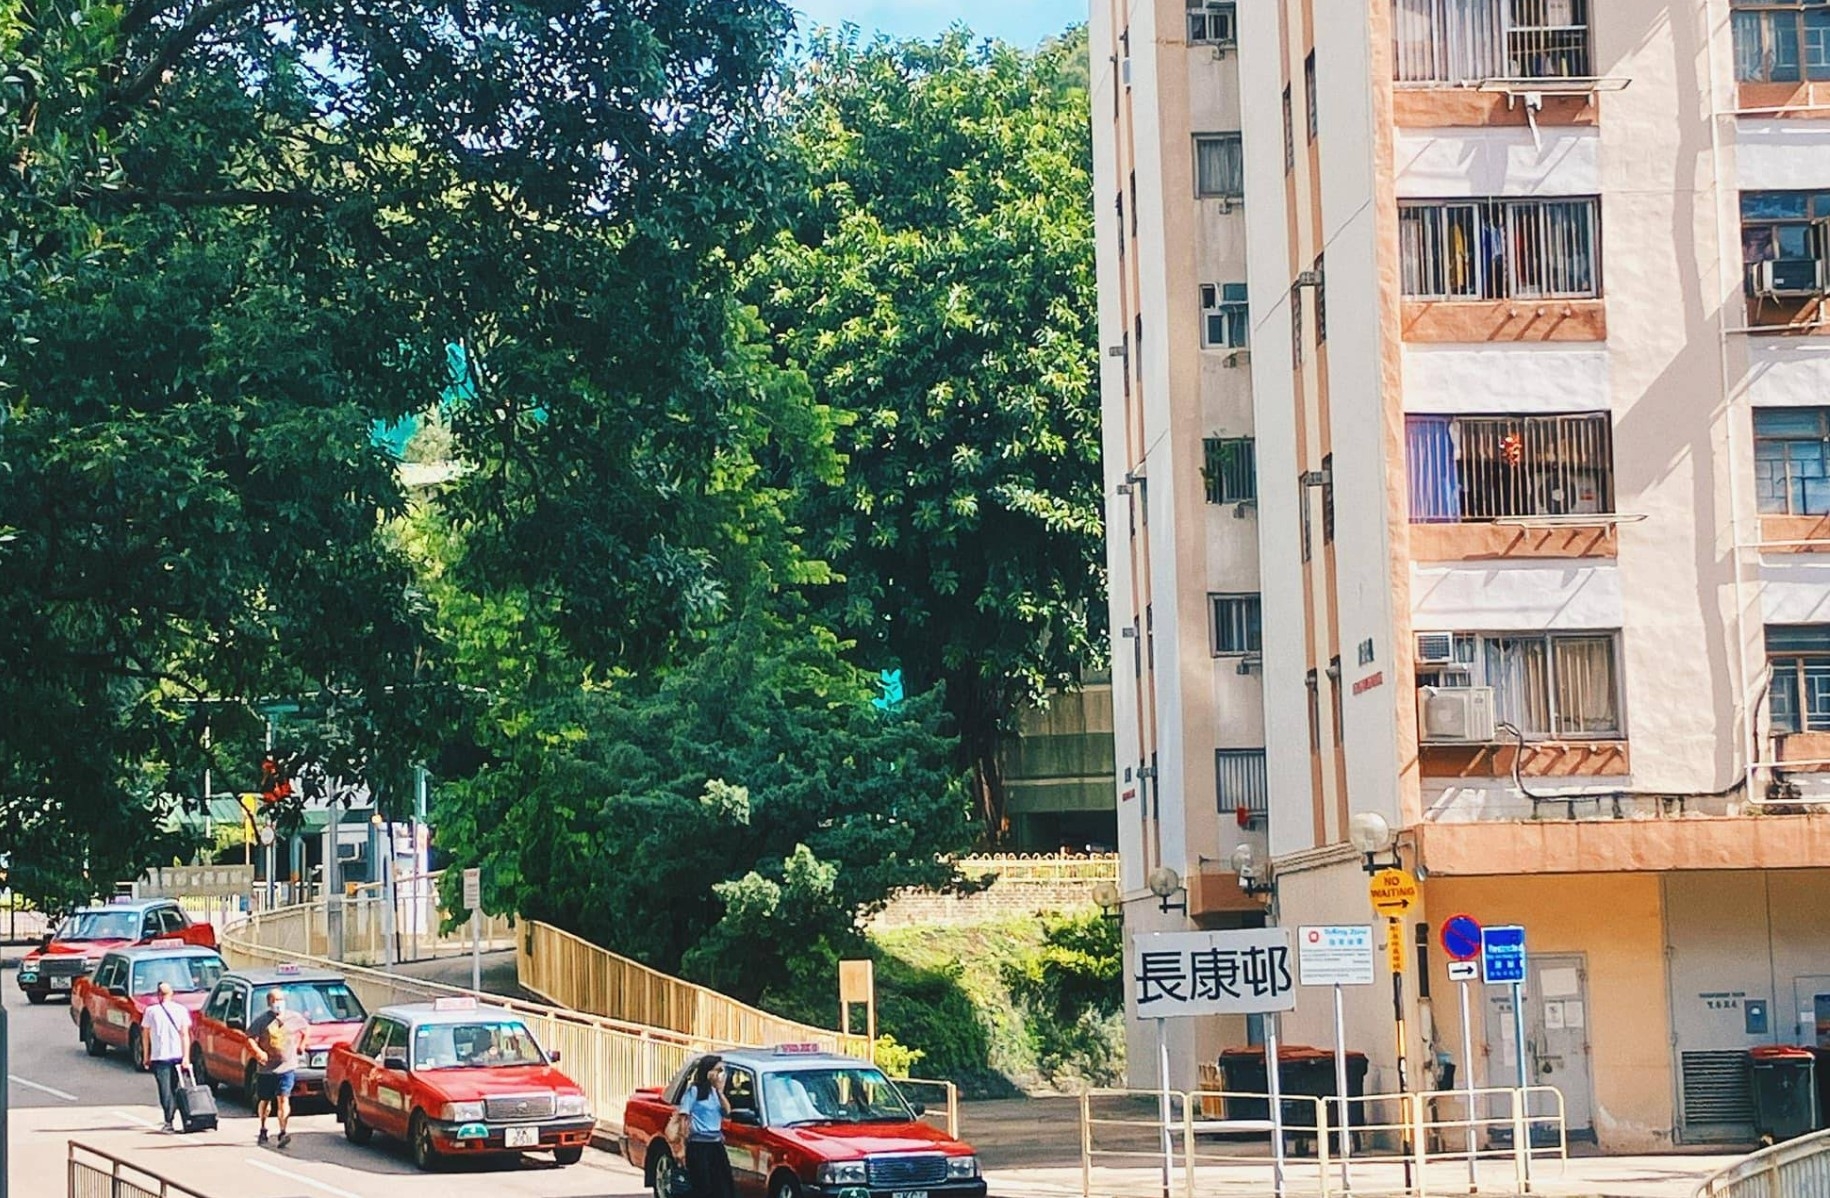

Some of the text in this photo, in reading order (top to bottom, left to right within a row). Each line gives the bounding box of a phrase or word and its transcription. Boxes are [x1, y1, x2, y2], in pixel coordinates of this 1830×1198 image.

[1384, 876, 1400, 886] NO
[1371, 887, 1415, 898] WAITING
[1135, 946, 1292, 1004] 長康邨
